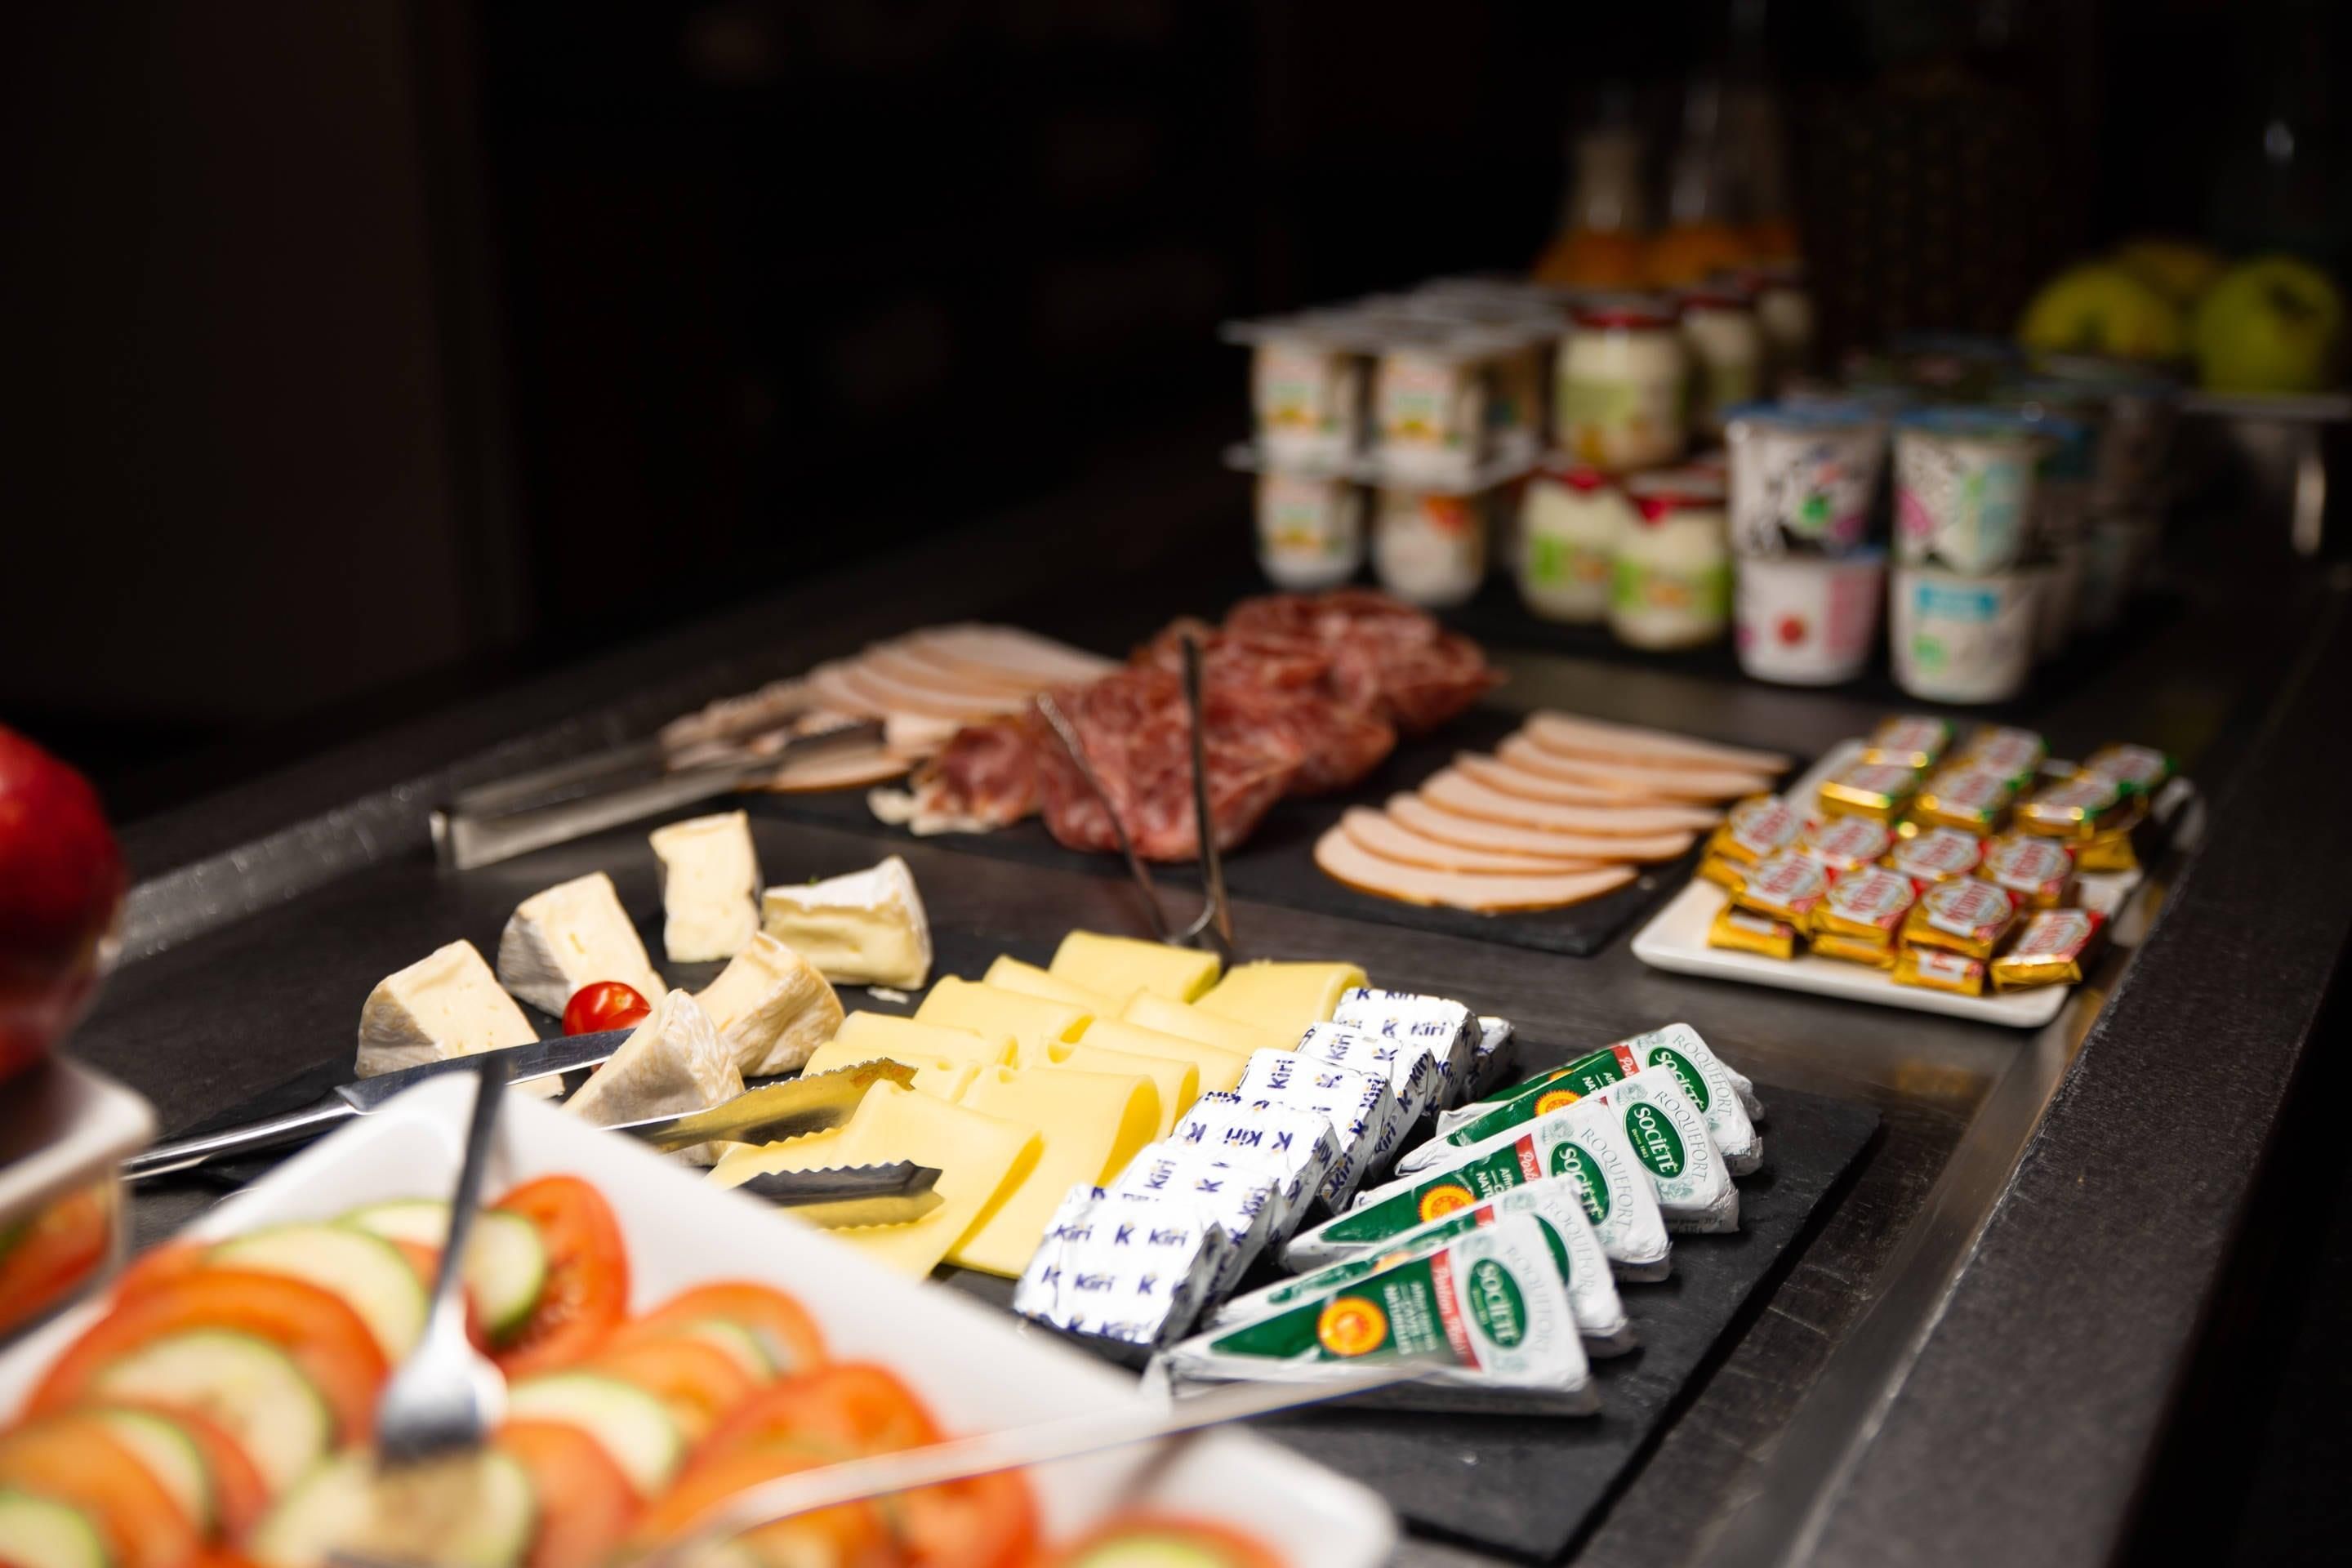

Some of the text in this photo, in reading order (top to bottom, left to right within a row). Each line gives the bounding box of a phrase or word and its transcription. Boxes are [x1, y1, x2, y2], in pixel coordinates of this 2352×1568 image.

[1411, 1022, 1446, 1036] Kiri
[1325, 1032, 1354, 1061] Kiri
[1267, 1059, 1295, 1089] Kiri
[1673, 1034, 1732, 1116] ROQUEFORT
[1223, 1128, 1263, 1147] Kiri
[1272, 1131, 1293, 1152] K
[1654, 1091, 1708, 1182] ROQUEFORT
[1144, 1159, 1176, 1189] Kiri
[1329, 1152, 1354, 1199] Kiri
[1581, 1128, 1633, 1230] ROQUEFORT
[1054, 1224, 1189, 1247] Kiri K Kiri
[1075, 1273, 1116, 1292] Kiri
[1138, 1275, 1157, 1294] K
